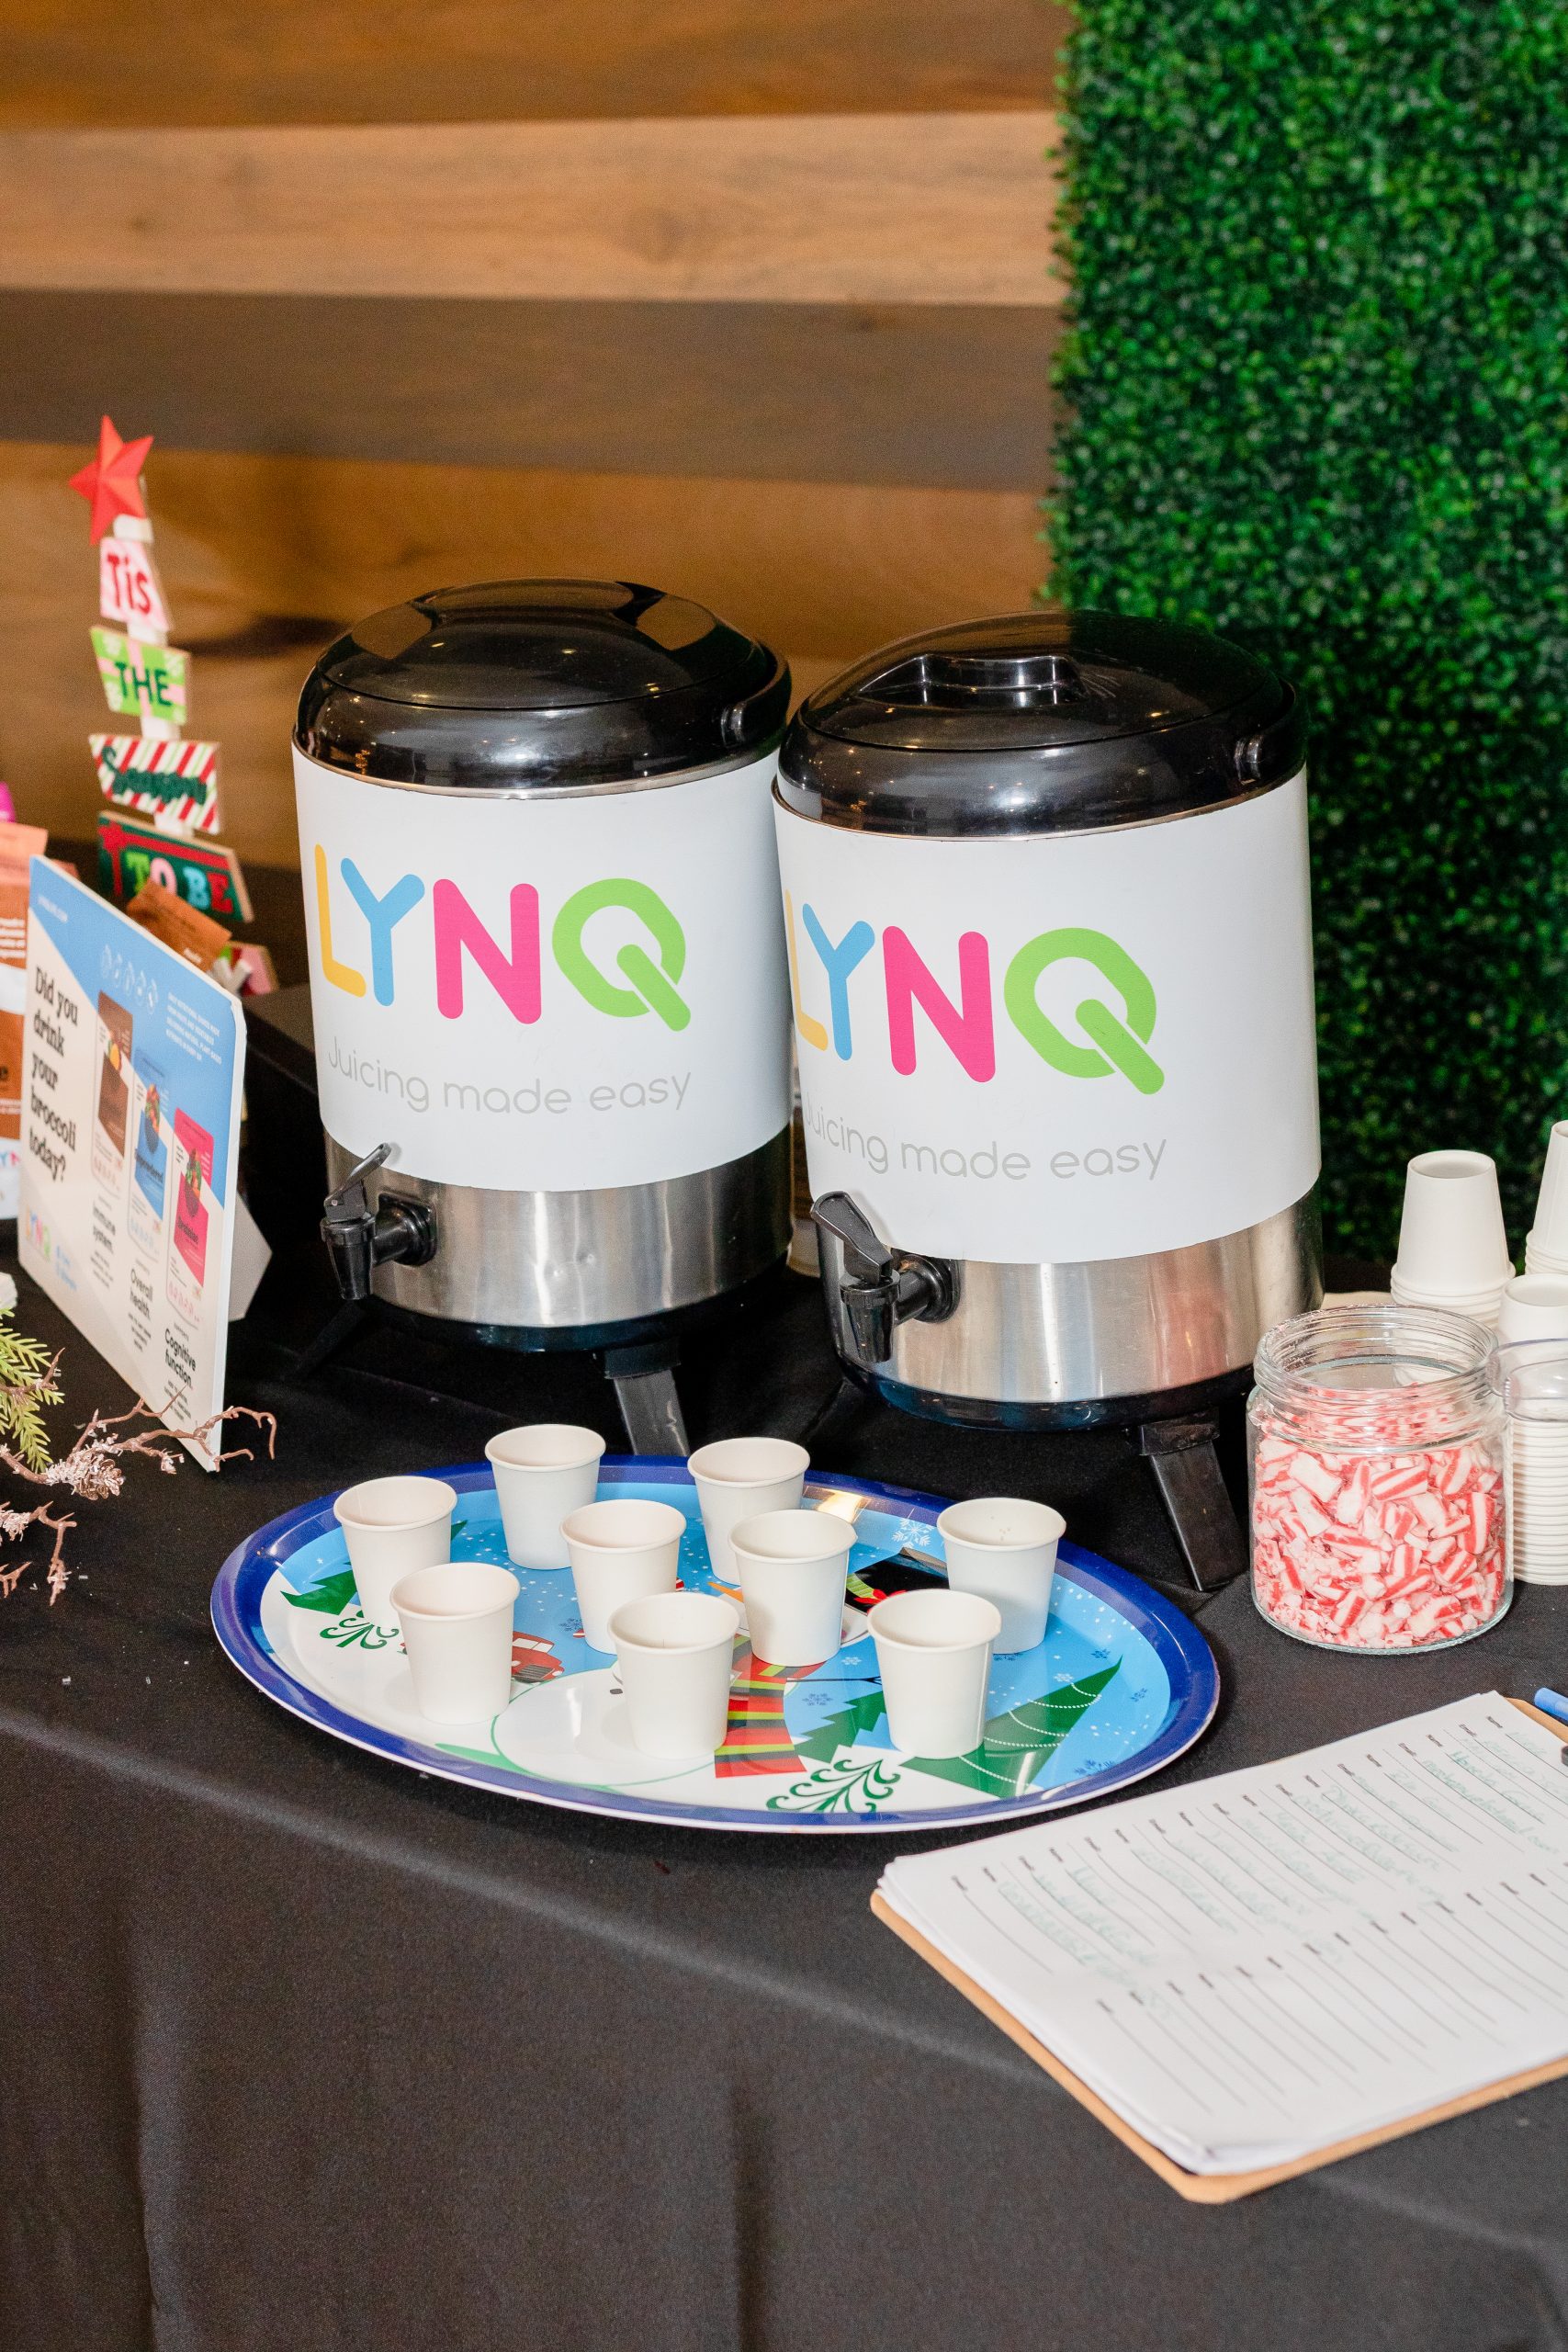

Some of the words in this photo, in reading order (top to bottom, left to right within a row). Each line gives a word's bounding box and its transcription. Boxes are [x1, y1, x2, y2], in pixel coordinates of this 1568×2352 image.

[114, 661, 173, 707] THE
[125, 851, 178, 896] TO
[183, 865, 234, 914] BE
[314, 843, 691, 1032] LYNQ
[35, 967, 54, 1005] Did
[57, 989, 79, 1027] you
[785, 888, 1165, 1095] LYNQ
[33, 1008, 65, 1057] drink
[31, 1052, 59, 1091] your
[328, 1036, 430, 1113] Juicing
[444, 1079, 572, 1115] made
[590, 1071, 691, 1111] easy
[30, 1083, 76, 1152] broccoli
[29, 1125, 67, 1182] today?
[901, 1141, 1031, 1181] made
[1050, 1139, 1167, 1181] easy
[130, 1268, 153, 1303] Overall
[164, 1328, 197, 1373] Cognitive
